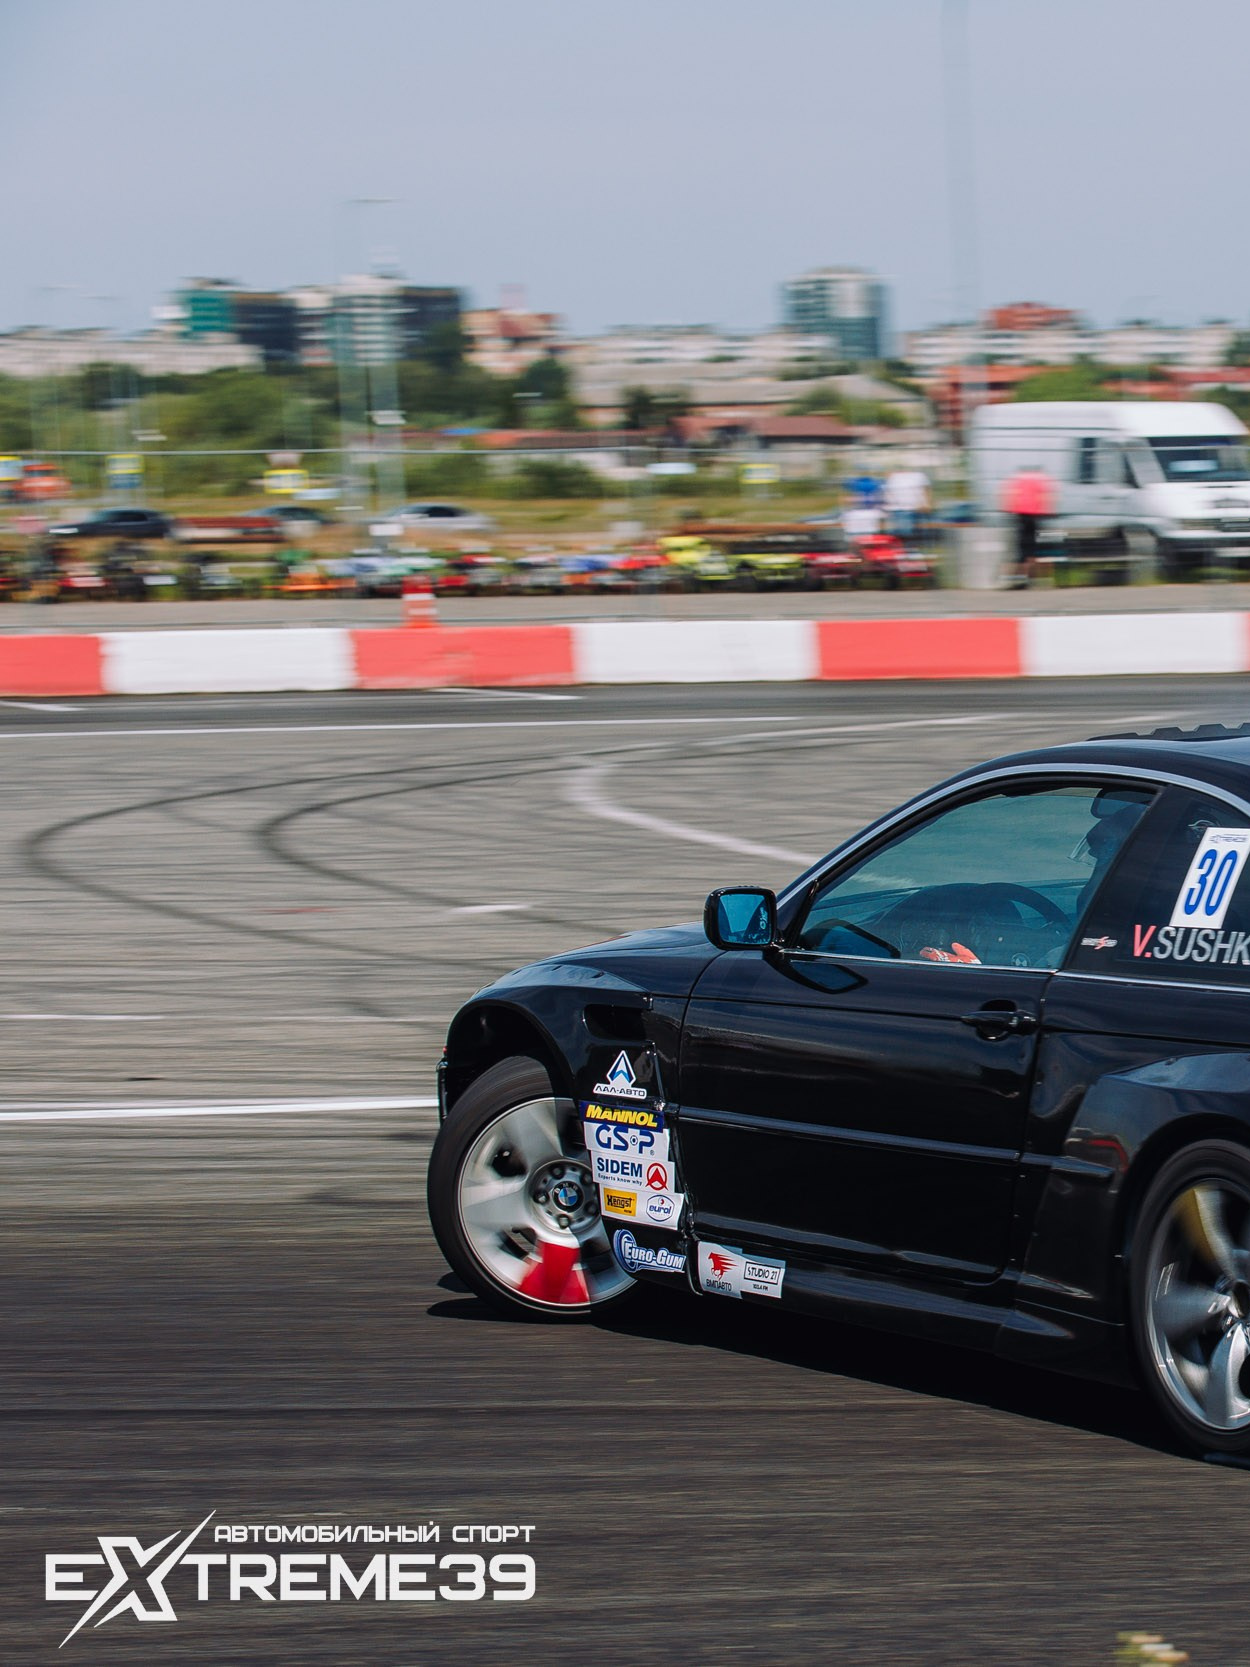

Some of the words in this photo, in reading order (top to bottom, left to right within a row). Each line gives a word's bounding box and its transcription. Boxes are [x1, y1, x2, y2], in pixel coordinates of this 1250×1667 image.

[1184, 849, 1238, 916] 30
[586, 1104, 658, 1128] MANNOL
[597, 1158, 643, 1178] SIDEM
[649, 1205, 672, 1214] eurol
[747, 1266, 770, 1279] STUDIO
[770, 1270, 778, 1280] 21
